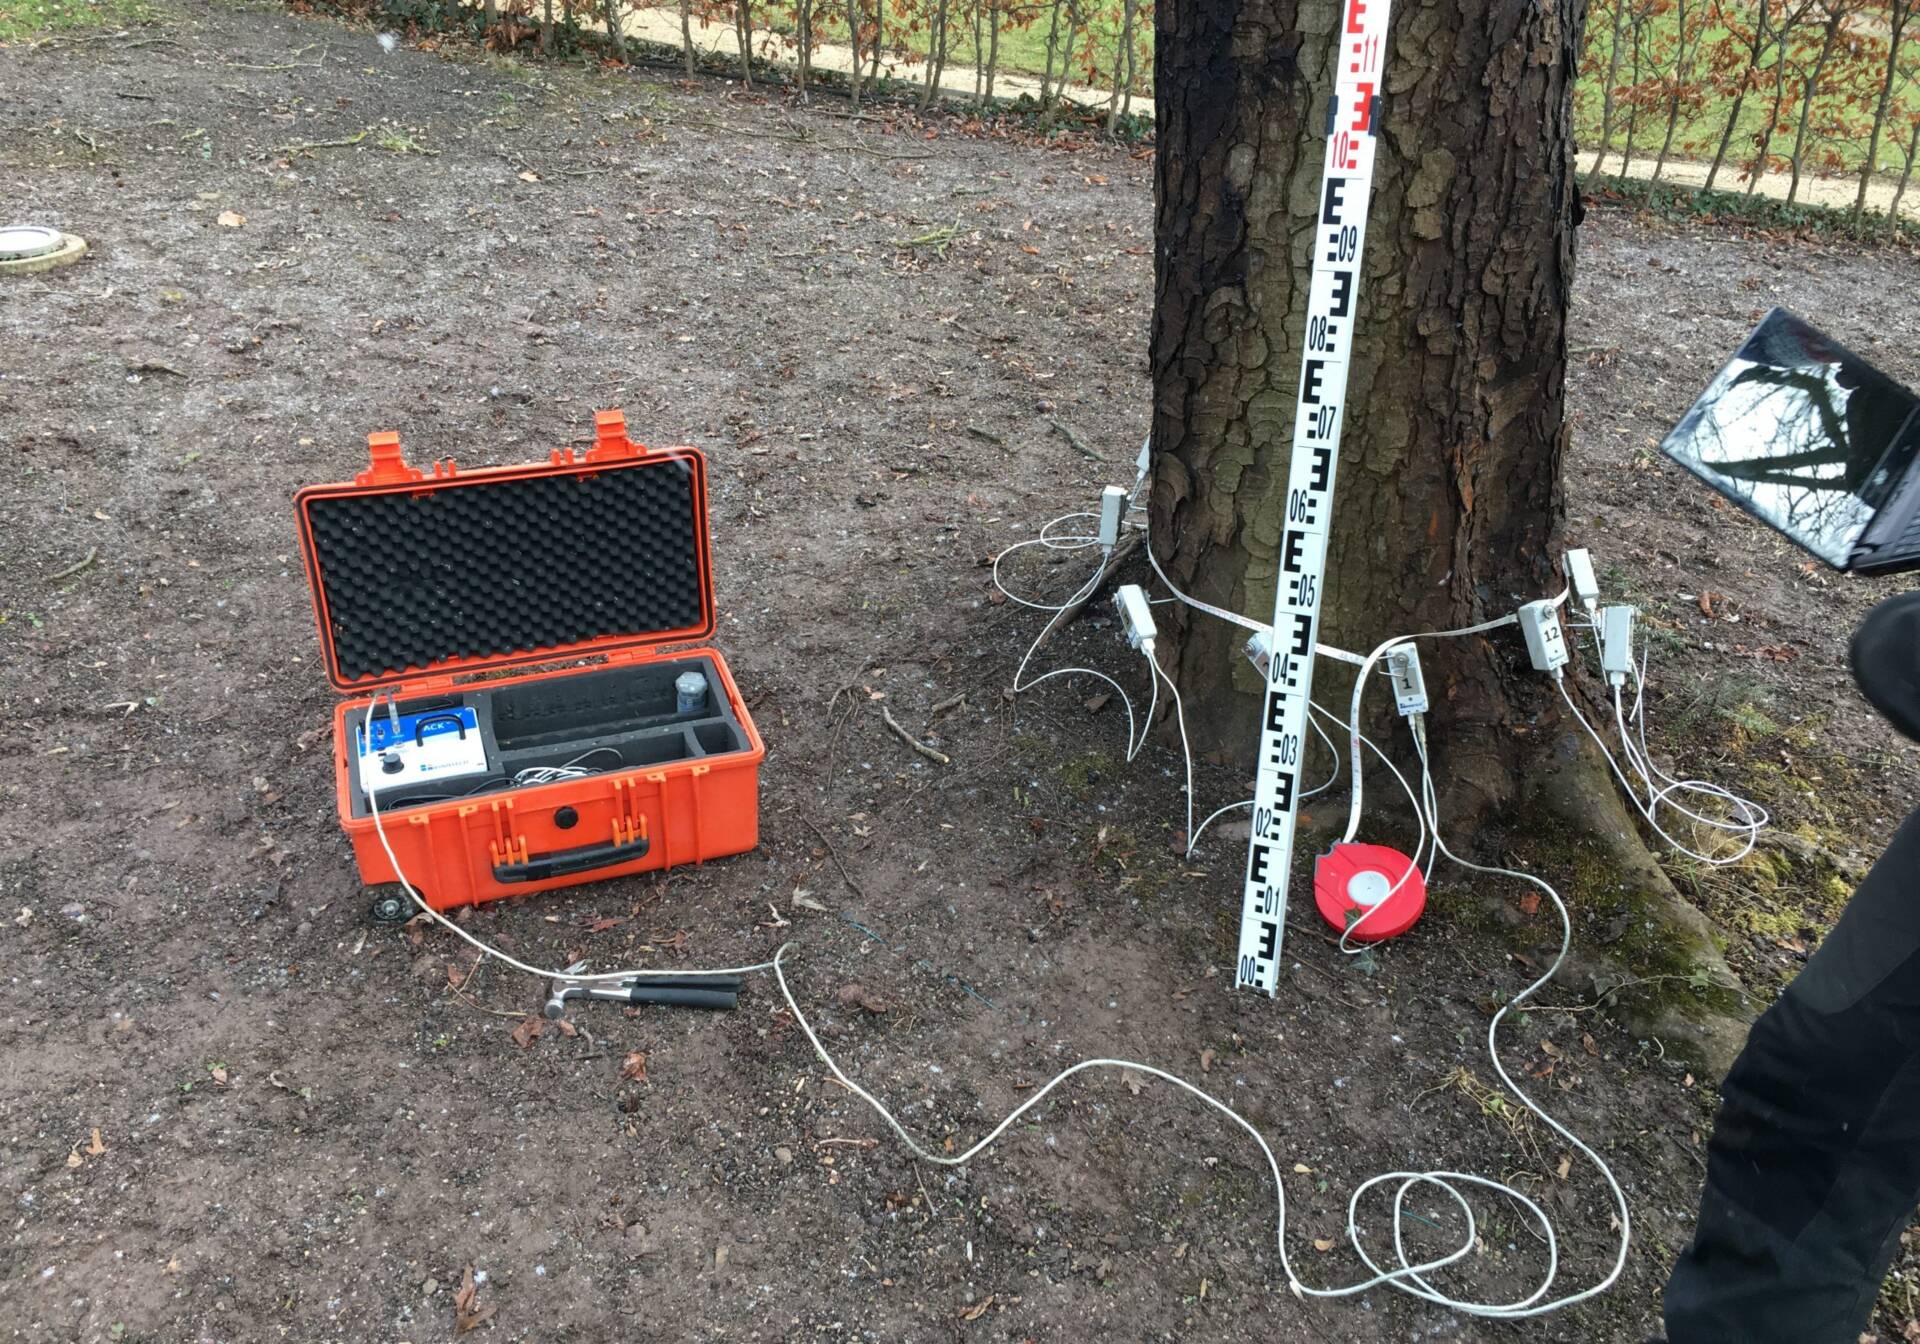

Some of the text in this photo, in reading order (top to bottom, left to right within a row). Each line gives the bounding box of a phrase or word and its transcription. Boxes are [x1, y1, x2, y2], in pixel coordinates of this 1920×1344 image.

[1363, 34, 1379, 73] 11
[1331, 131, 1349, 169] 10
[1338, 225, 1358, 263] 09
[1308, 315, 1327, 351] 08
[1317, 404, 1337, 440] 07
[1289, 488, 1308, 523] 06
[1298, 573, 1317, 608] 05
[1543, 626, 1560, 642] 12
[1271, 651, 1290, 685] 04
[1401, 677, 1412, 690] 1
[1281, 733, 1298, 766] 03
[1255, 807, 1272, 839] 02
[1264, 885, 1280, 917] 01
[1240, 954, 1256, 985] 00
